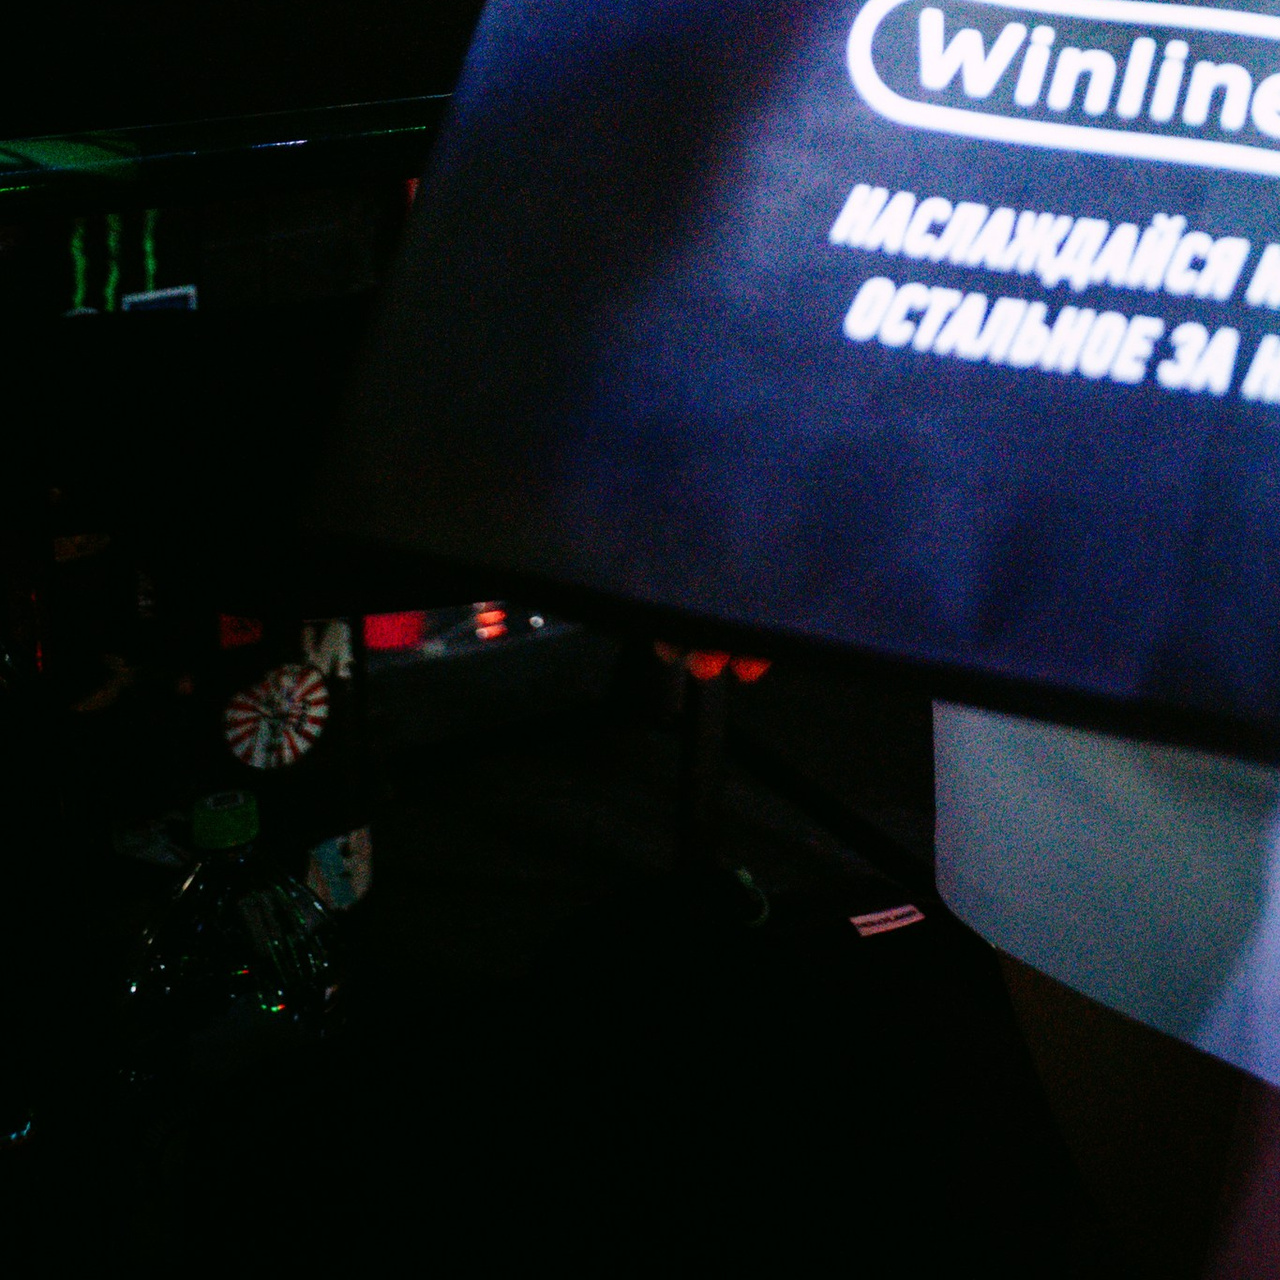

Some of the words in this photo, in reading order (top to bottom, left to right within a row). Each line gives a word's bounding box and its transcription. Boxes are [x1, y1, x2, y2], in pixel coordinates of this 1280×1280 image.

[829, 183, 1250, 302] НАСЛАЖДАЙСЯ
[844, 276, 1163, 383] ОСТАЛЬНОЕ
[1157, 322, 1239, 395] ЗА
